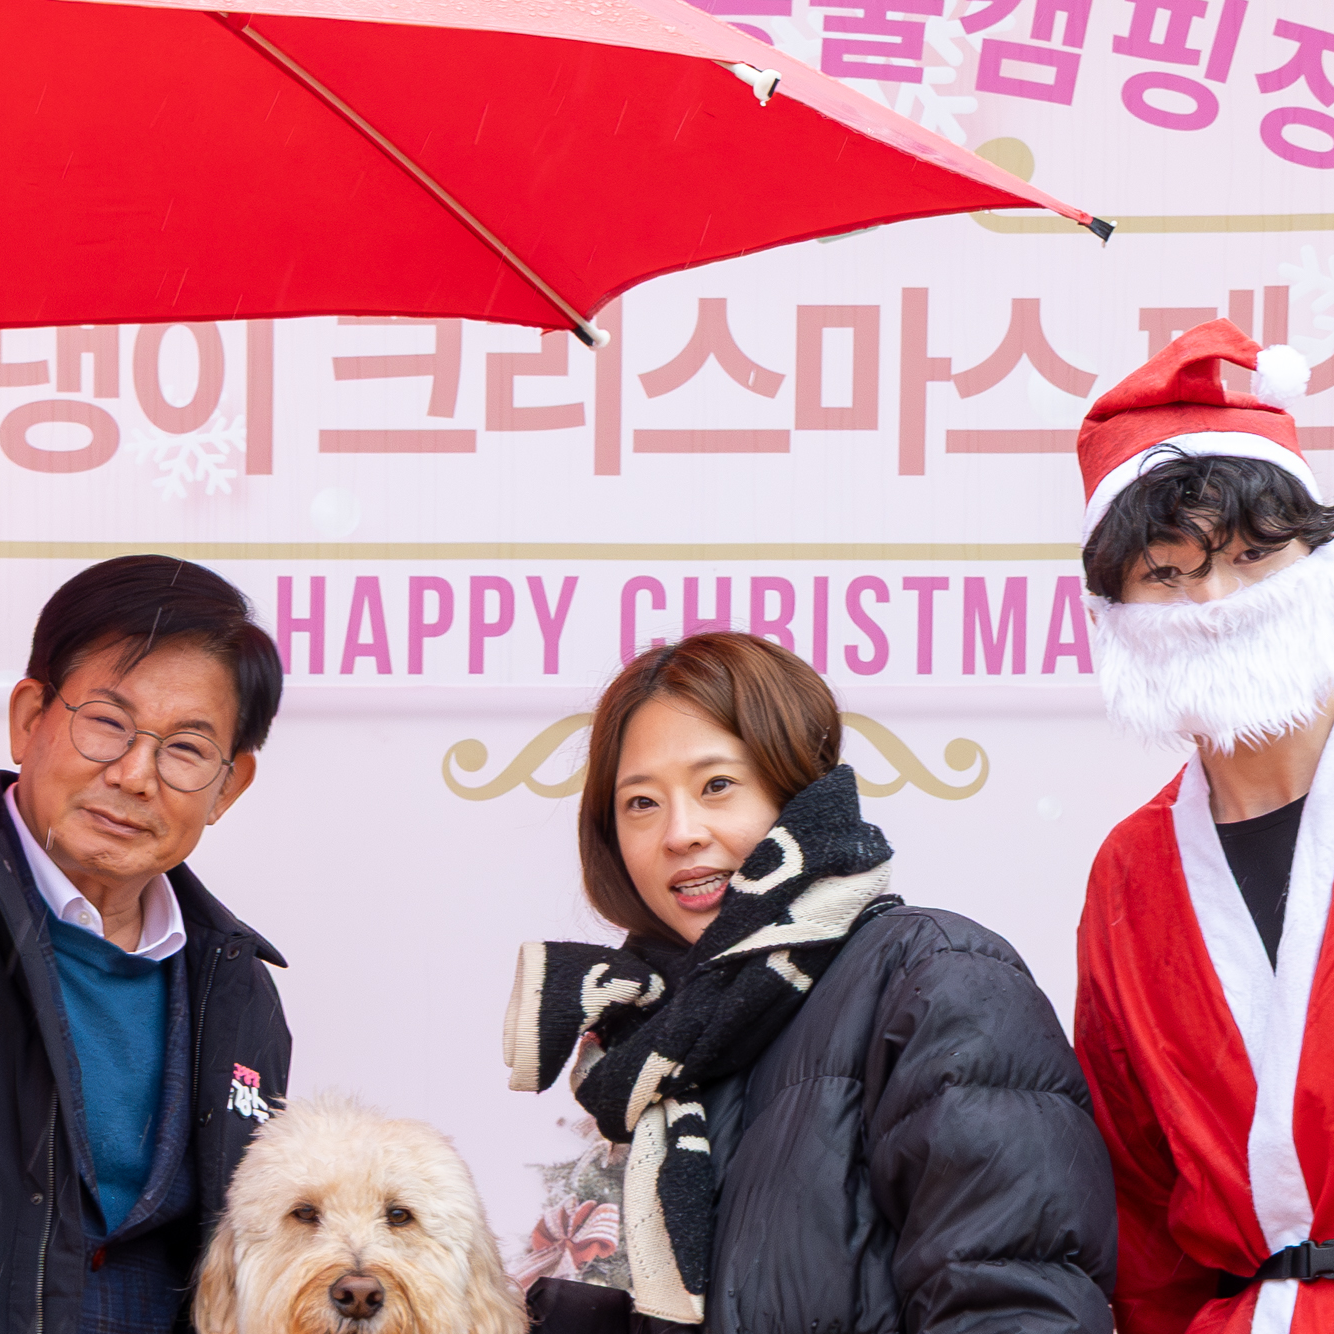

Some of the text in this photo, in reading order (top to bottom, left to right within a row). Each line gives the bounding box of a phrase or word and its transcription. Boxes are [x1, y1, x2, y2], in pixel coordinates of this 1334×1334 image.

[318, 285, 1098, 477] 크리스마스
[277, 575, 1094, 676] HAPPY CHRISTMA
